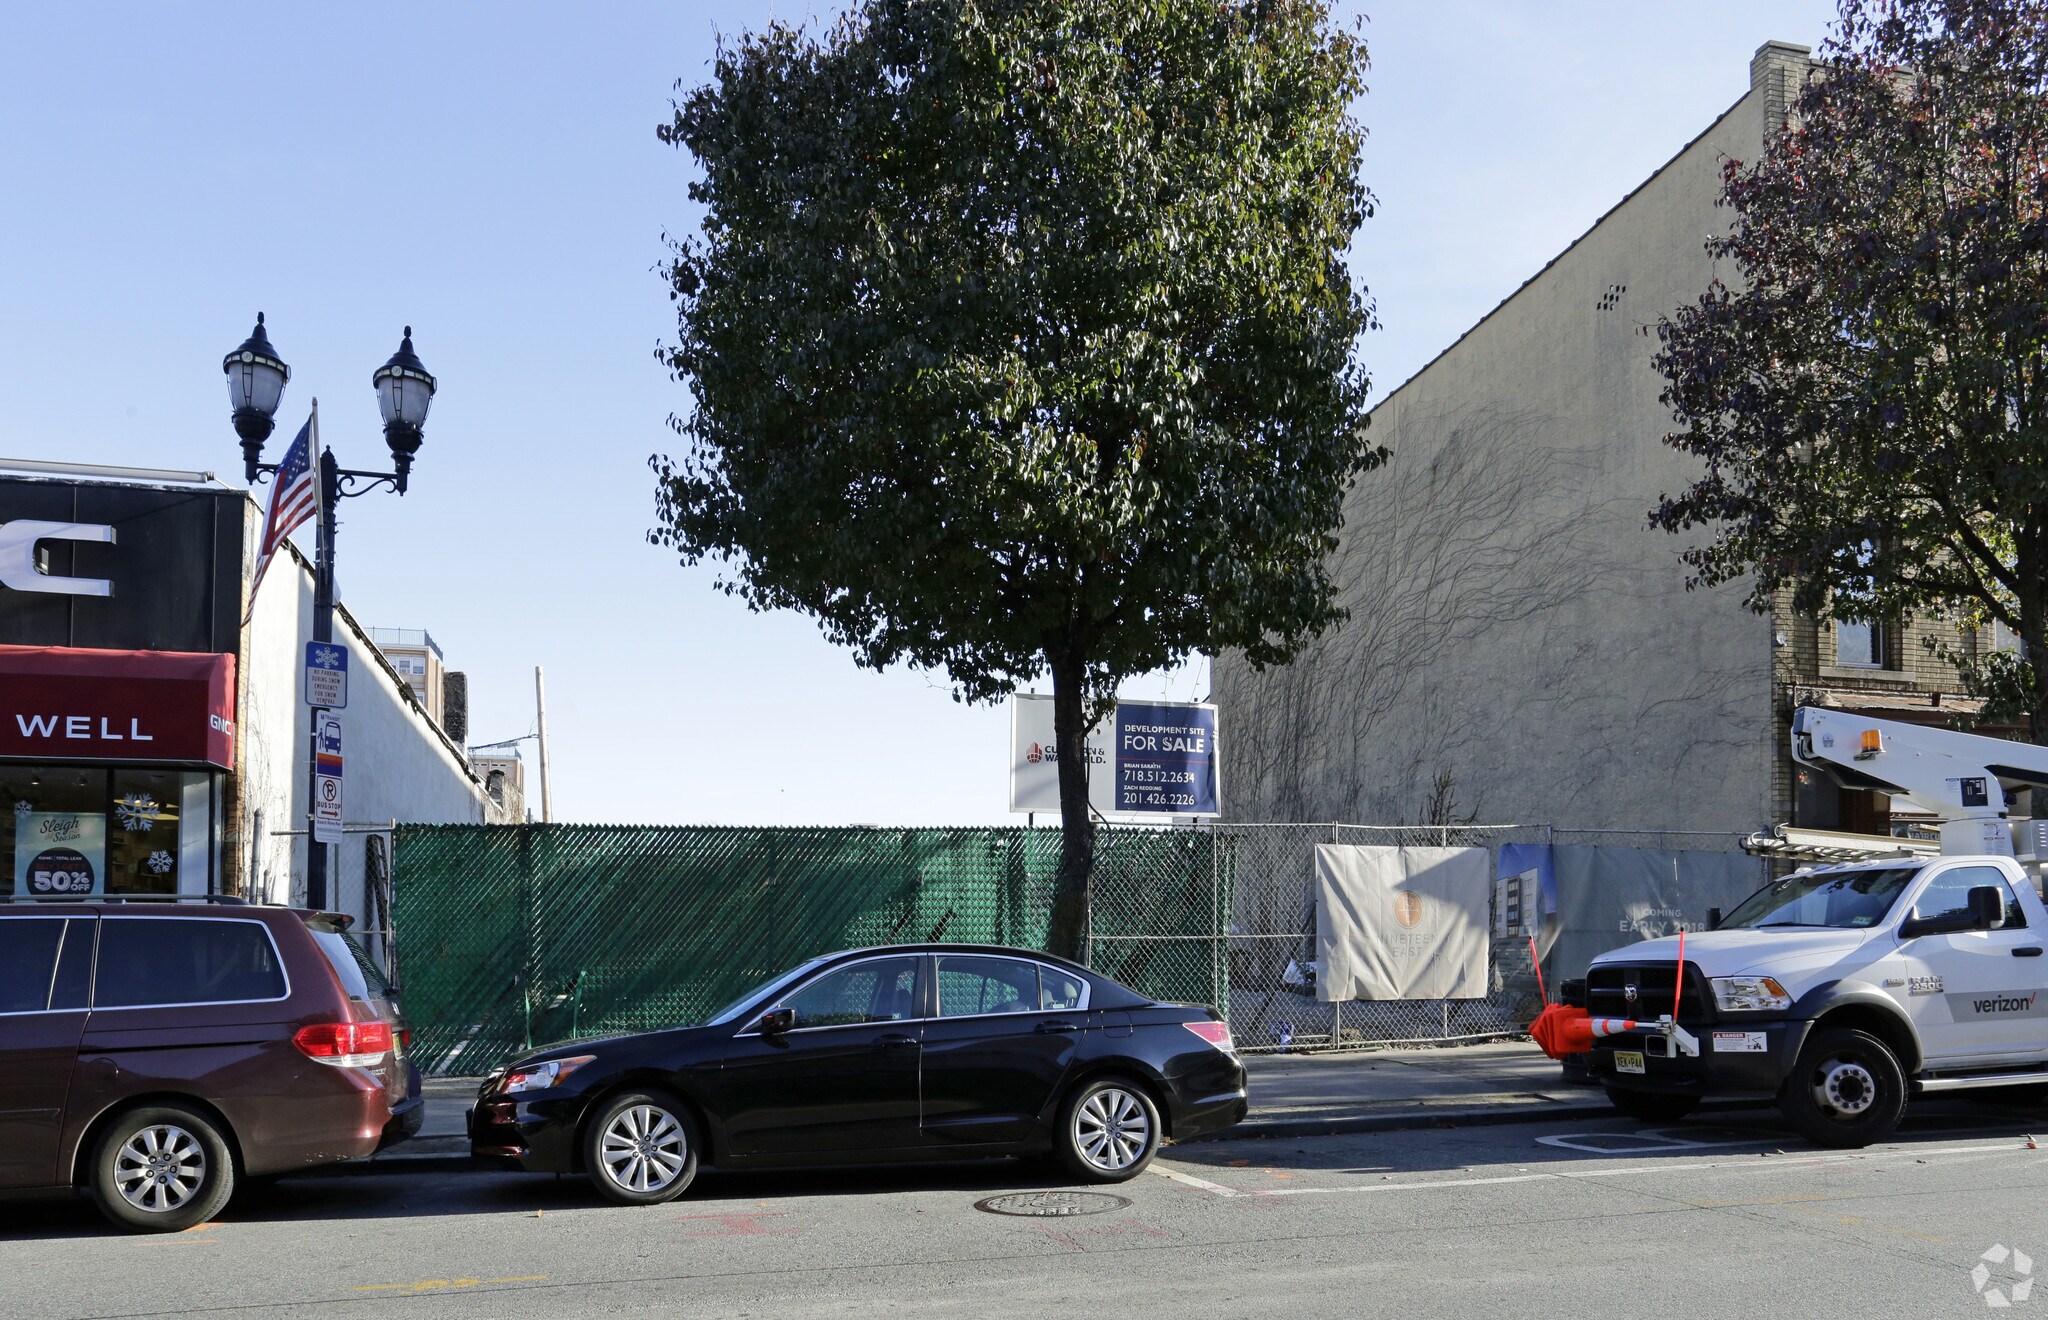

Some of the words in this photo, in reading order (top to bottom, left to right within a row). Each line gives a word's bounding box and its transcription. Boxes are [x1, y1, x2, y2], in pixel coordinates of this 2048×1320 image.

[321, 669, 339, 677] PARKING
[16, 714, 153, 741] WELL
[210, 714, 232, 735] GNC
[1124, 724, 1187, 734] DEVELOPMENT
[1189, 728, 1205, 736] SITE
[1124, 735, 1157, 751] FOR
[1162, 737, 1204, 753] SALE
[1124, 770, 1195, 783] 718.512.2634
[1124, 792, 1195, 805] 201.426.2226
[328, 802, 341, 810] STOP
[40, 816, 79, 835] Sleigh
[53, 832, 80, 842] Season
[1644, 908, 1681, 917] COMING
[1620, 920, 1667, 933] EARLY
[1673, 922, 1705, 934] 2018
[1376, 932, 1439, 944] NINETEEN
[1392, 947, 1422, 957] EAST
[1973, 994, 2029, 1013] verizon
